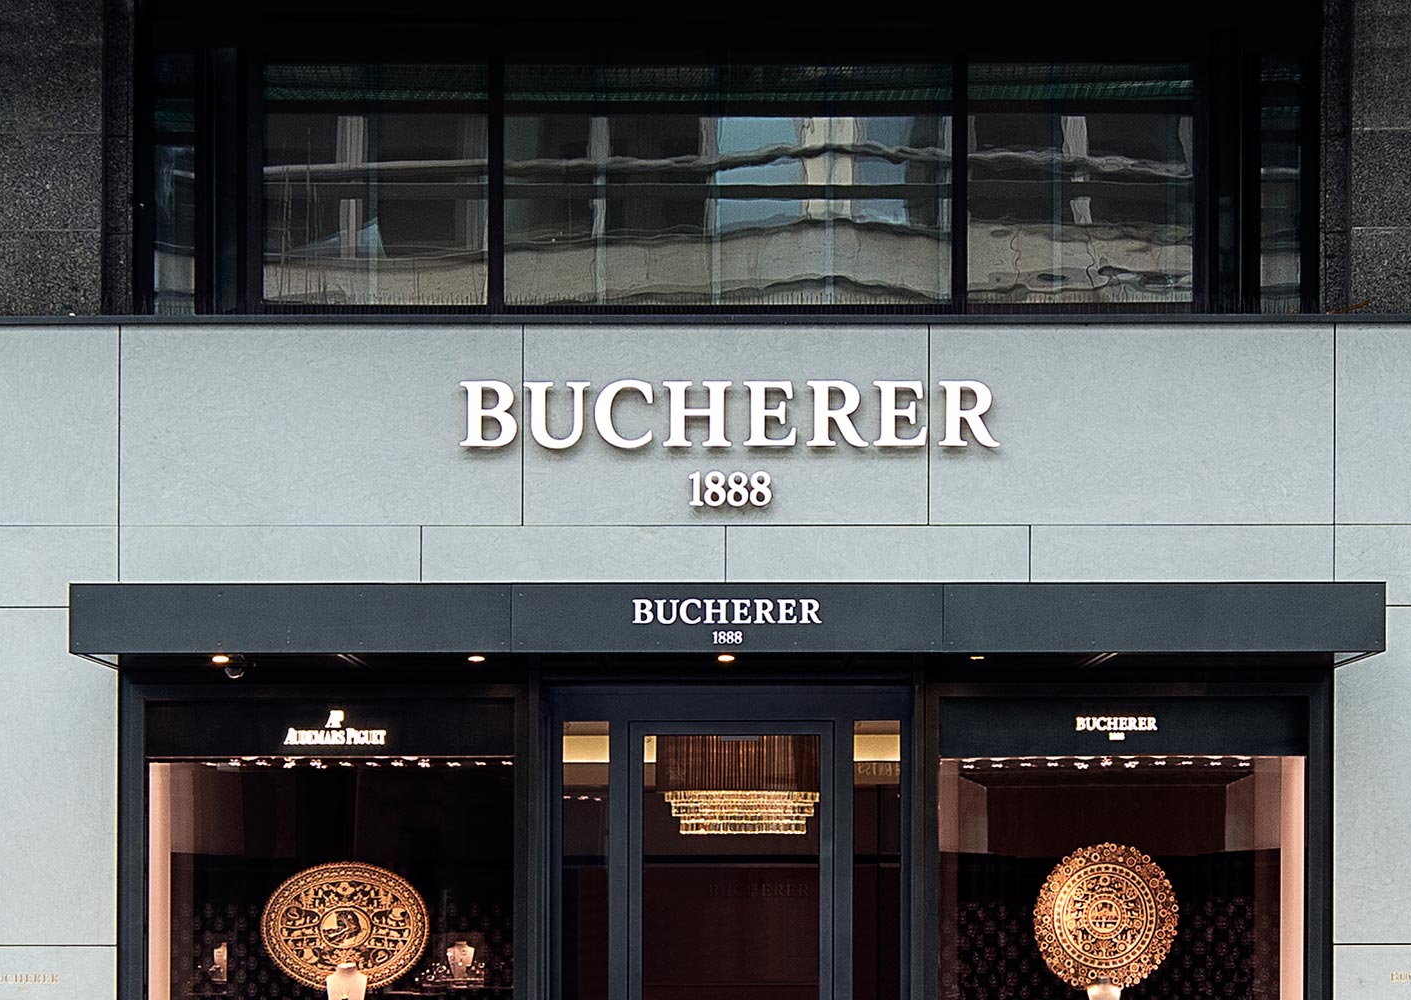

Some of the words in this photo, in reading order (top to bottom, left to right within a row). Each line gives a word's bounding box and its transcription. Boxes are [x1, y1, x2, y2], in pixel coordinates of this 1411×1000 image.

[459, 379, 1001, 450] BUCHERER
[688, 470, 773, 507] 1888
[632, 598, 823, 625] BUCHERER
[712, 630, 743, 645] 1888
[1075, 716, 1158, 731] BUCHERER
[283, 727, 345, 746] AUDEMARS
[345, 727, 387, 746] PIGUET
